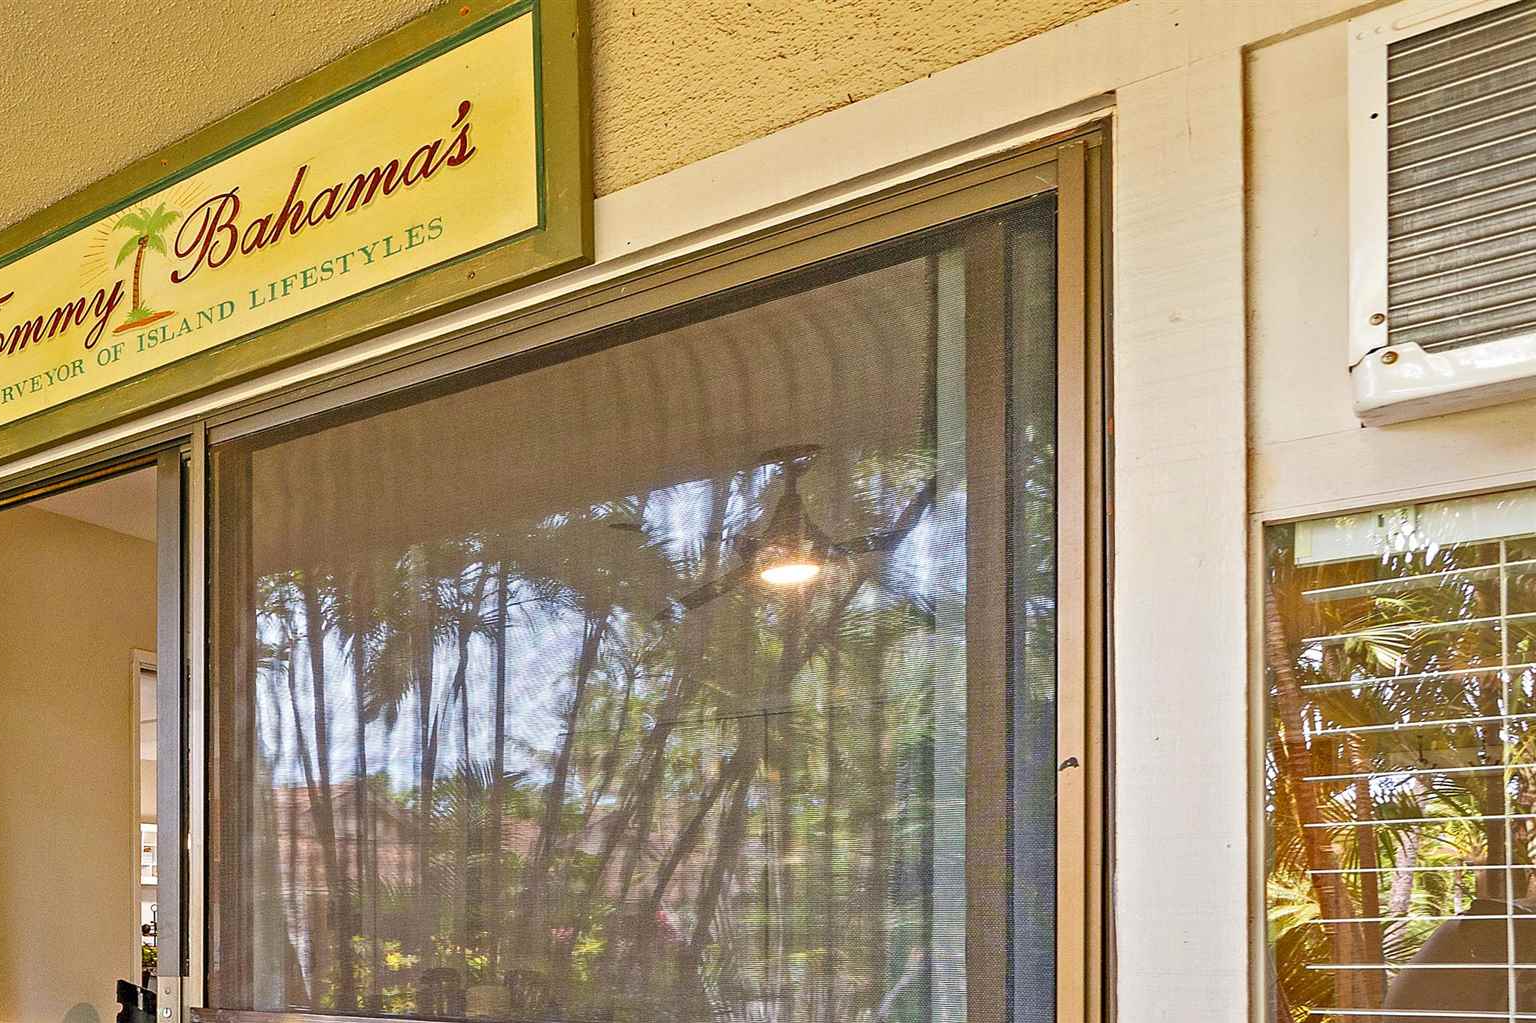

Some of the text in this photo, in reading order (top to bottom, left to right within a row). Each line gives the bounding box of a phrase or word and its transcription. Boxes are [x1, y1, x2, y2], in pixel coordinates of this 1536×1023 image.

[170, 100, 476, 283] Bahama's
[97, 342, 125, 367] OF
[137, 300, 235, 352] ISLAND
[249, 216, 444, 310] LIFESTYLES
